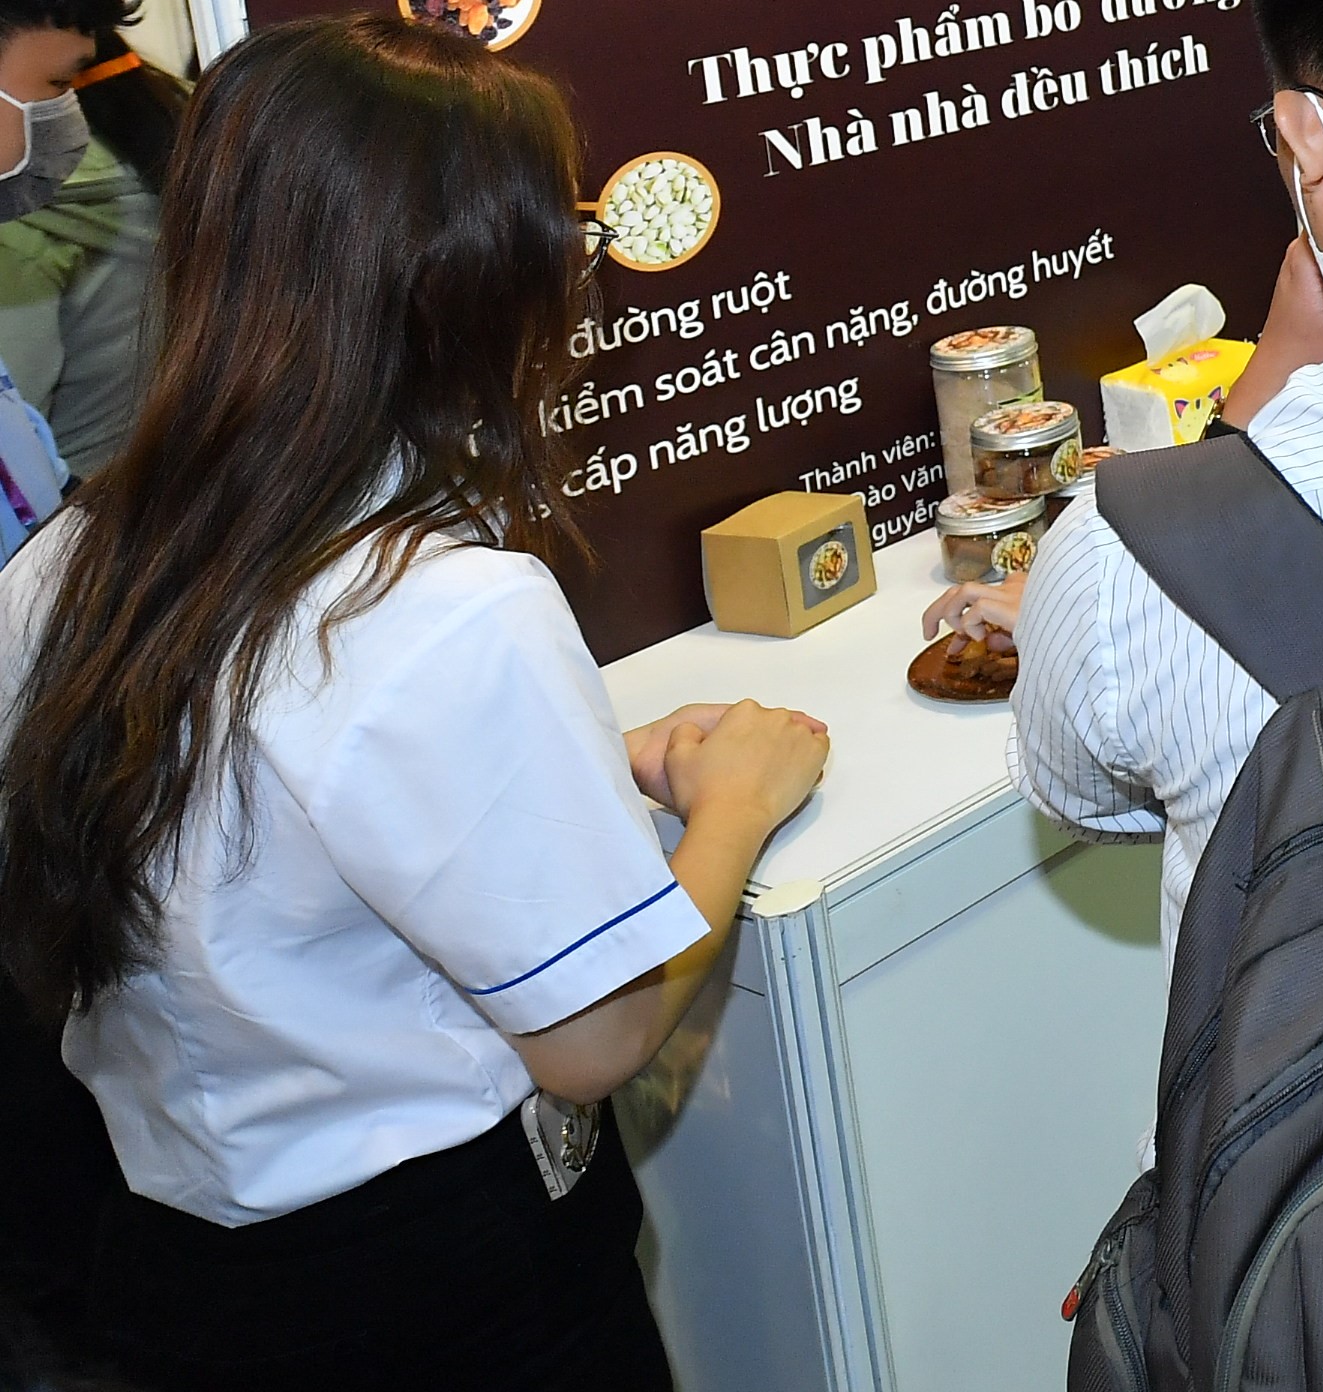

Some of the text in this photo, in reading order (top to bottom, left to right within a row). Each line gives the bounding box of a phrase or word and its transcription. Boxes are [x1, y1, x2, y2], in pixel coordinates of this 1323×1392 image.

[687, 38, 850, 106] Thực
[862, 2, 1014, 85] phẩm
[759, 34, 1211, 178] Nhà nhà đều thích
[538, 228, 1115, 438] kiểm soát cân nặng, đường huyết
[569, 268, 793, 360] đường ruột
[561, 372, 862, 498] cấp năng lượng
[799, 431, 936, 494] Thành viên:
[901, 463, 944, 493] Văn
